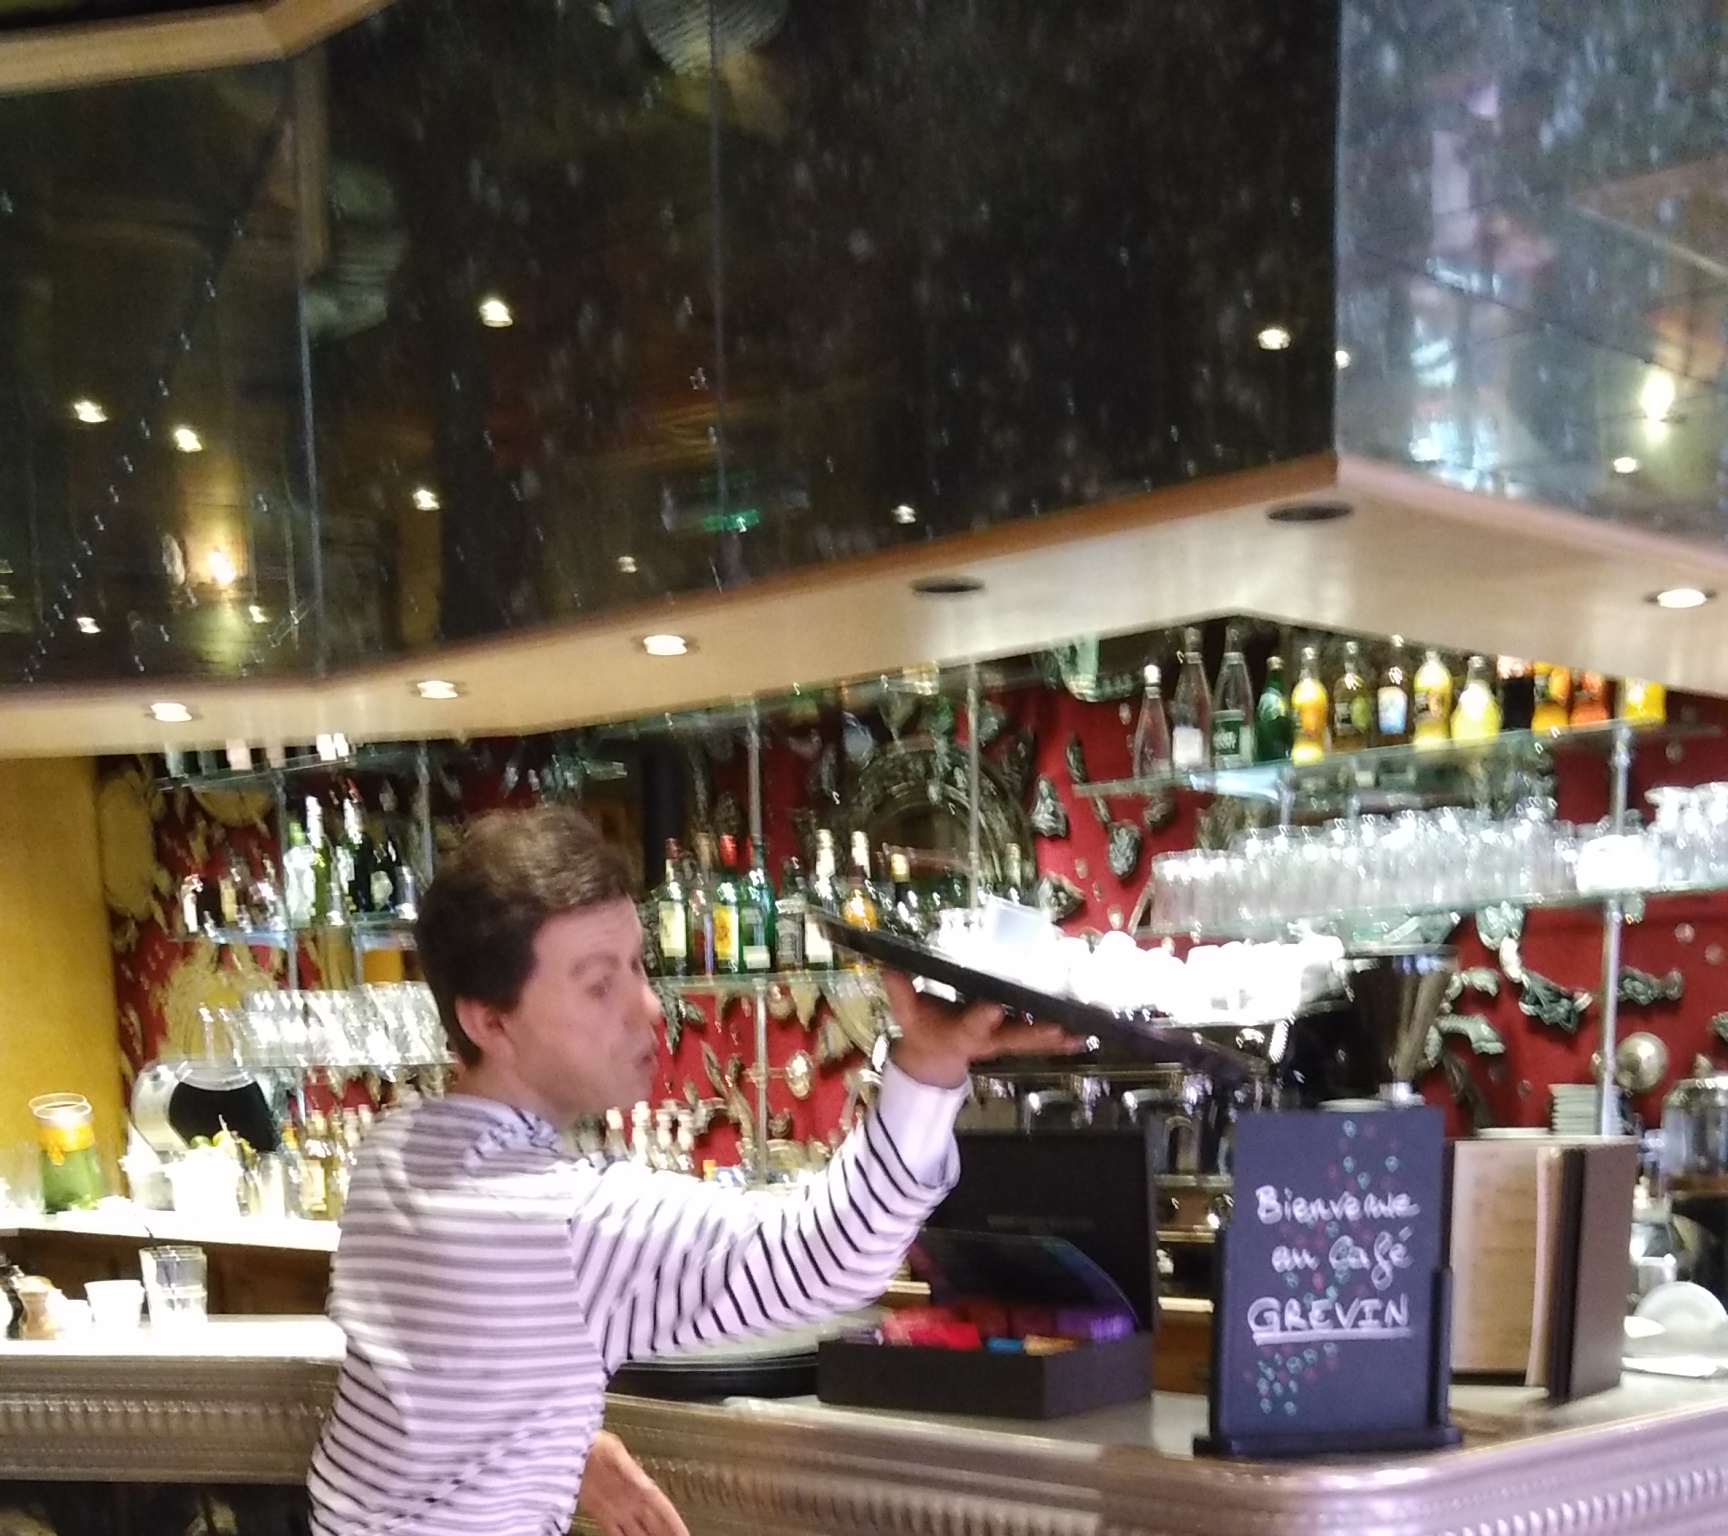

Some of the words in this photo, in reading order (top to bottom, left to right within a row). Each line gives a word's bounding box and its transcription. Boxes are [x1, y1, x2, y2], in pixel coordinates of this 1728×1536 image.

[1255, 1185, 1420, 1224] Bienvenue
[1271, 1245, 1320, 1273] au
[1247, 1293, 1409, 1333] GREVIN
